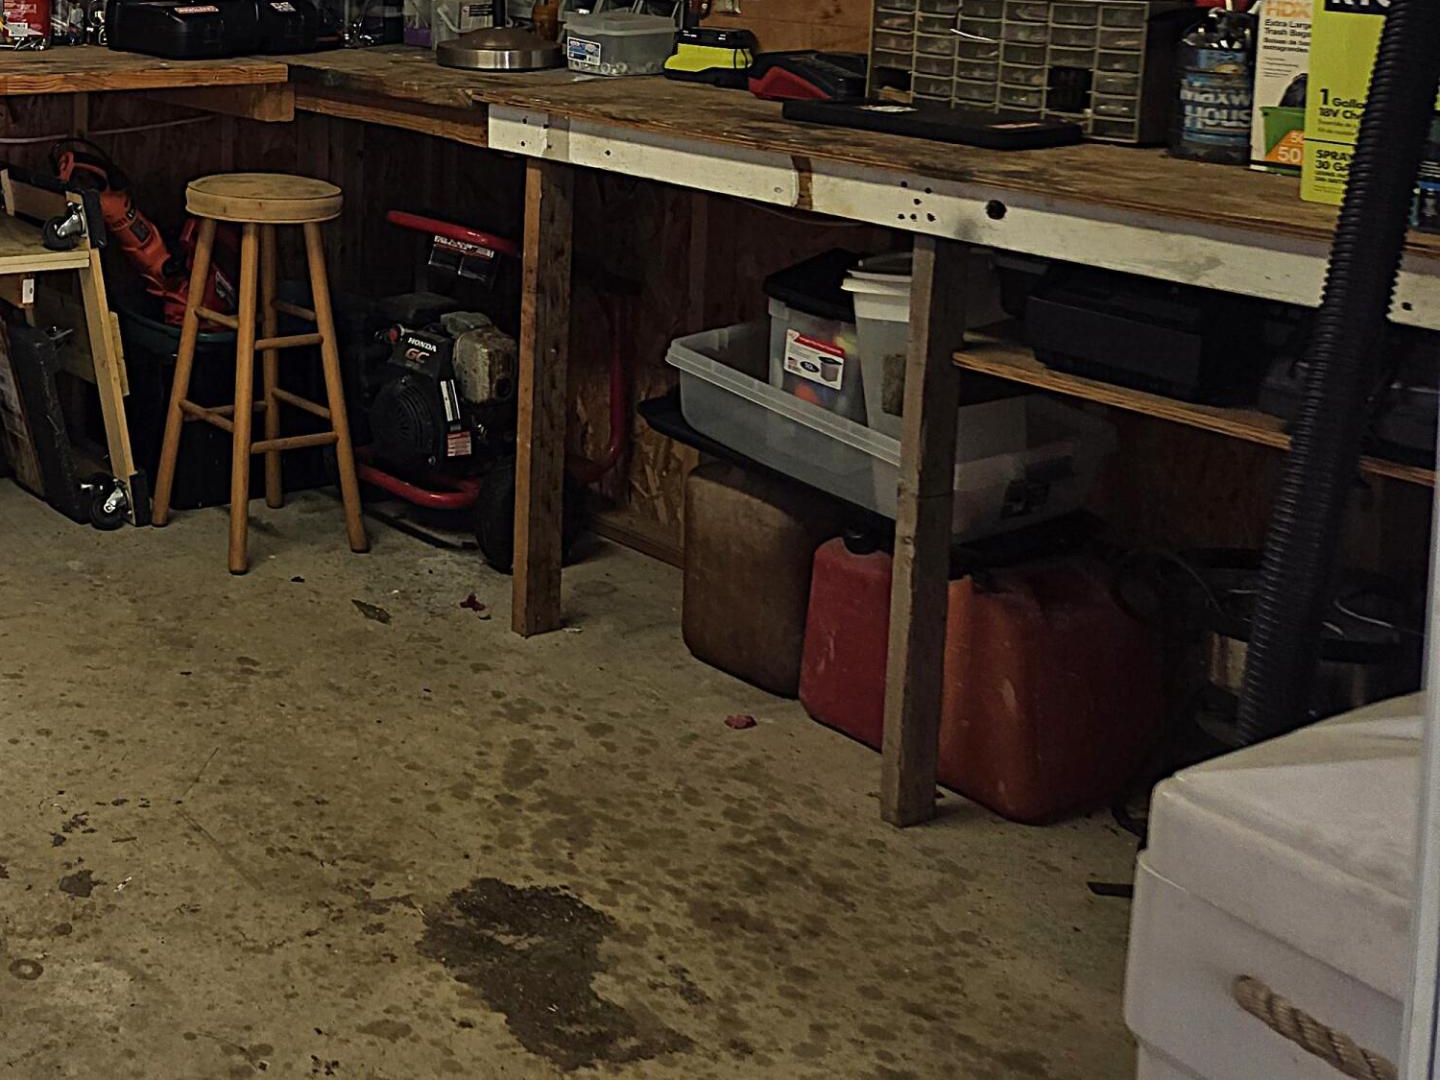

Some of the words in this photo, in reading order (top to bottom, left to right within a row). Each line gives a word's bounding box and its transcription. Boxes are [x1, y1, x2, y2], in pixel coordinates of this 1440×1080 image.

[1264, 19, 1288, 27] Extra
[1264, 27, 1288, 36] Trash
[1320, 88, 1329, 105] 1
[1332, 97, 1366, 109] Gallo
[407, 337, 437, 352] HONDA
[405, 348, 430, 363] GC
